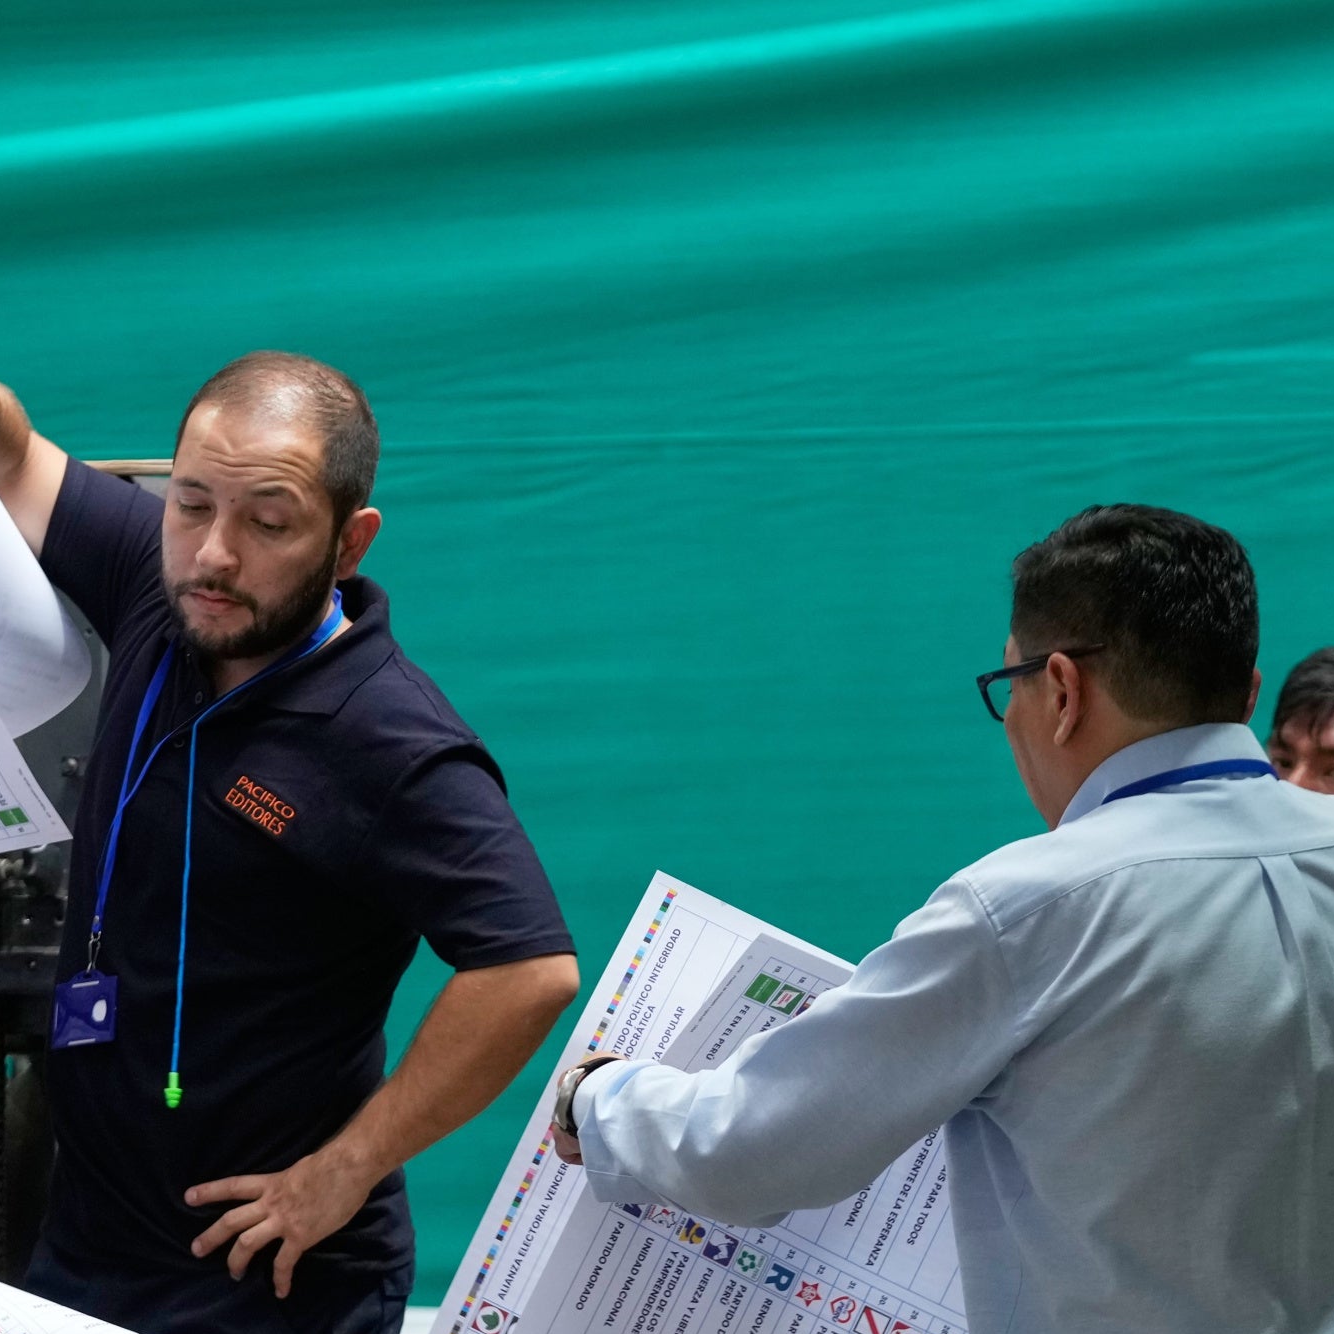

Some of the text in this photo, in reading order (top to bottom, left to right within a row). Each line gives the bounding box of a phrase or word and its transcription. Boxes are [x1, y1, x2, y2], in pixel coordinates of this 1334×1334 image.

[225, 787, 286, 835] EDITORES
[610, 927, 681, 1055] RTIDO POLÍTICO INTEGRIDAD
[622, 1005, 656, 1060] MOCRÁTICA
[657, 1005, 685, 1050] POPULAR
[705, 1004, 751, 1061] FE EN EL PERÚ
[864, 1146, 930, 1266] FRENTE DE LA ESPERANZA
[905, 1182, 943, 1246] PARA TODOS
[497, 1162, 569, 1301] ALIANZA ELECTORAL VENCER
[575, 1220, 625, 1311] PARTIDO MORADO
[629, 1236, 655, 1276] UNIDAD
[662, 1254, 690, 1298] PARTIDO
[764, 1262, 795, 1291] R
[603, 1275, 636, 1327] NACIONAL
[655, 1298, 668, 1313] DE
[689, 1266, 714, 1304] FUERZA
[719, 1278, 737, 1306] PERÚ
[721, 1284, 748, 1328] PARTIDO
[645, 1312, 661, 1333] LOS
